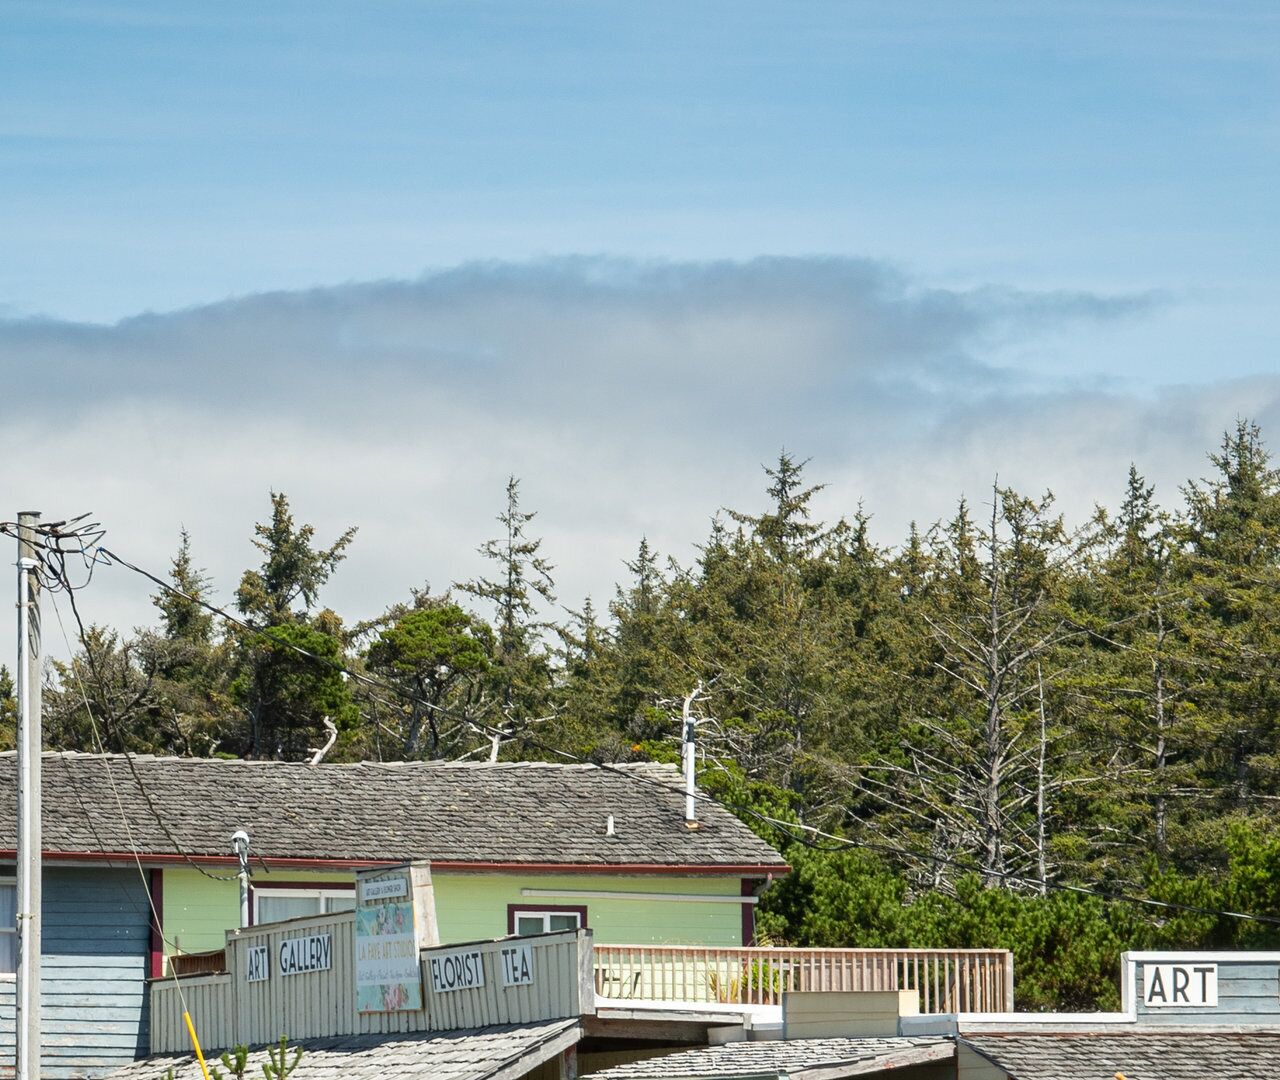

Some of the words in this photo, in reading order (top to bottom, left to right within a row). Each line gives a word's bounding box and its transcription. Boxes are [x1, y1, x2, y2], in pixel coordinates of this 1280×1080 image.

[248, 948, 266, 981] ART
[280, 936, 331, 973] GALLERY
[431, 952, 480, 990] FLORIST
[501, 947, 531, 983] TEA
[1148, 966, 1215, 1003] ART
